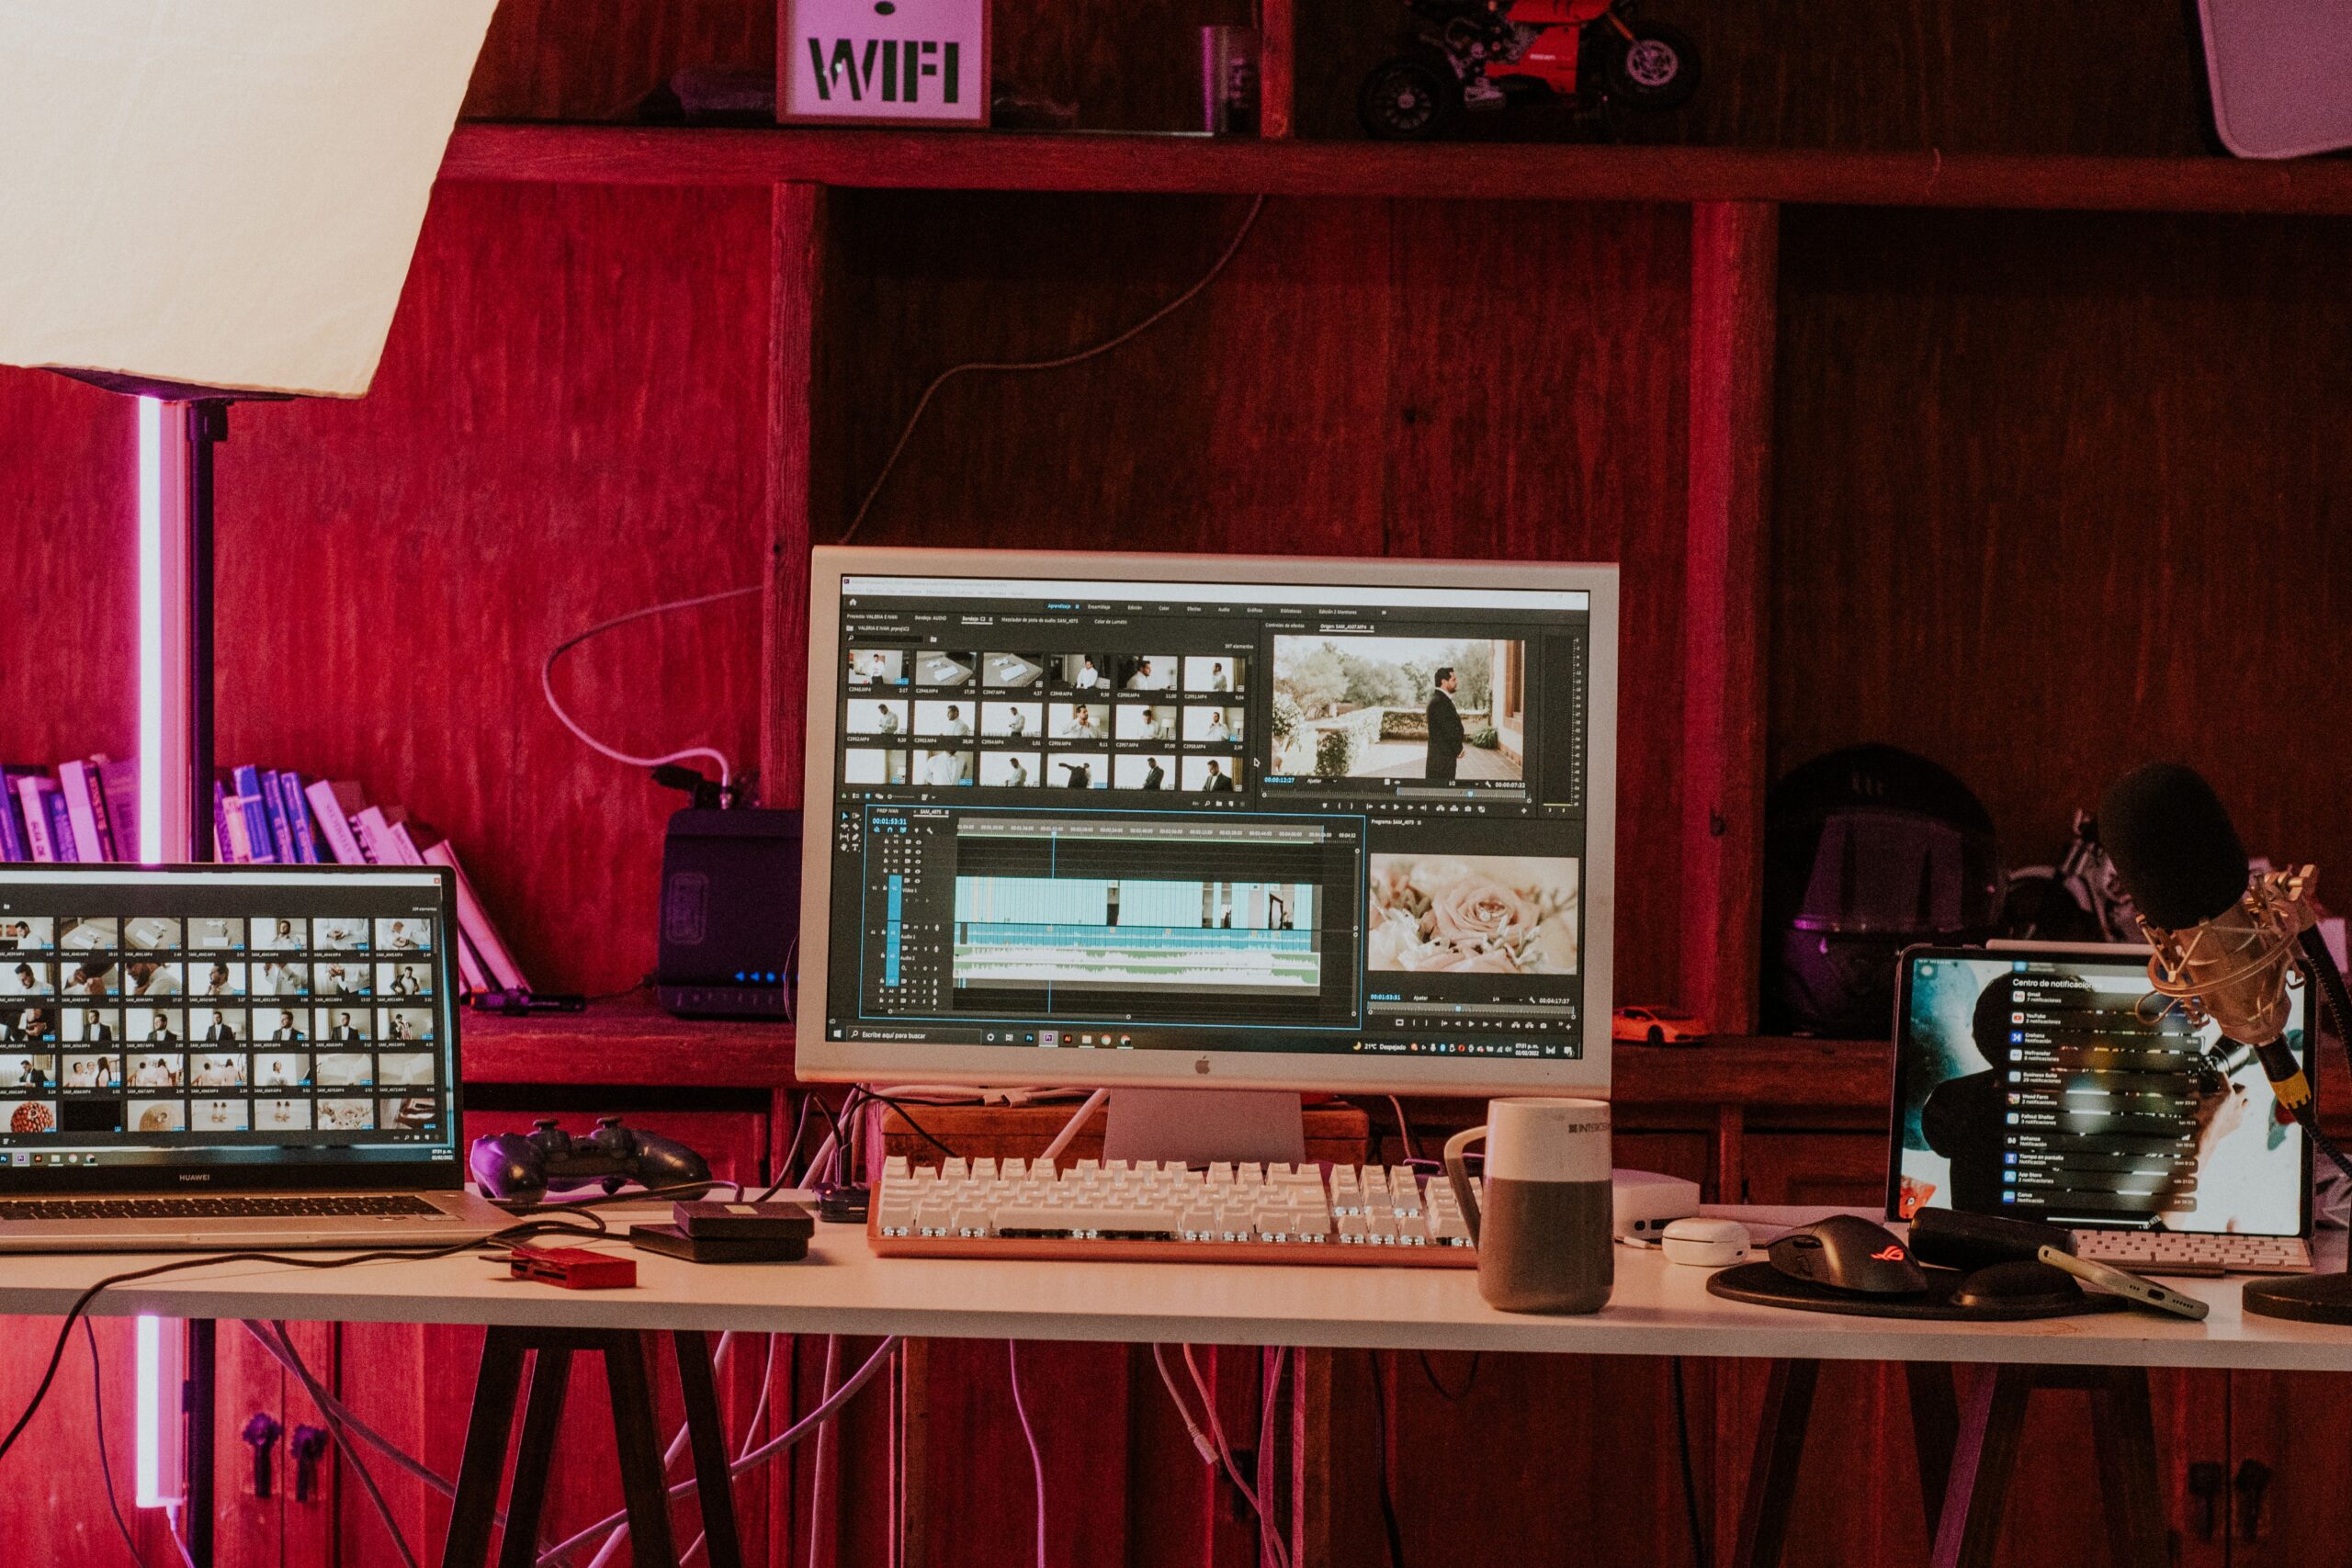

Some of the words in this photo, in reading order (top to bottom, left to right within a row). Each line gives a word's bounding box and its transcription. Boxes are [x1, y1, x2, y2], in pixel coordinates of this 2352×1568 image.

[808, 38, 959, 103] WIFI
[2012, 978, 2039, 987] Centro
[2040, 979, 2049, 987] de
[2050, 979, 2102, 989] notificacion
